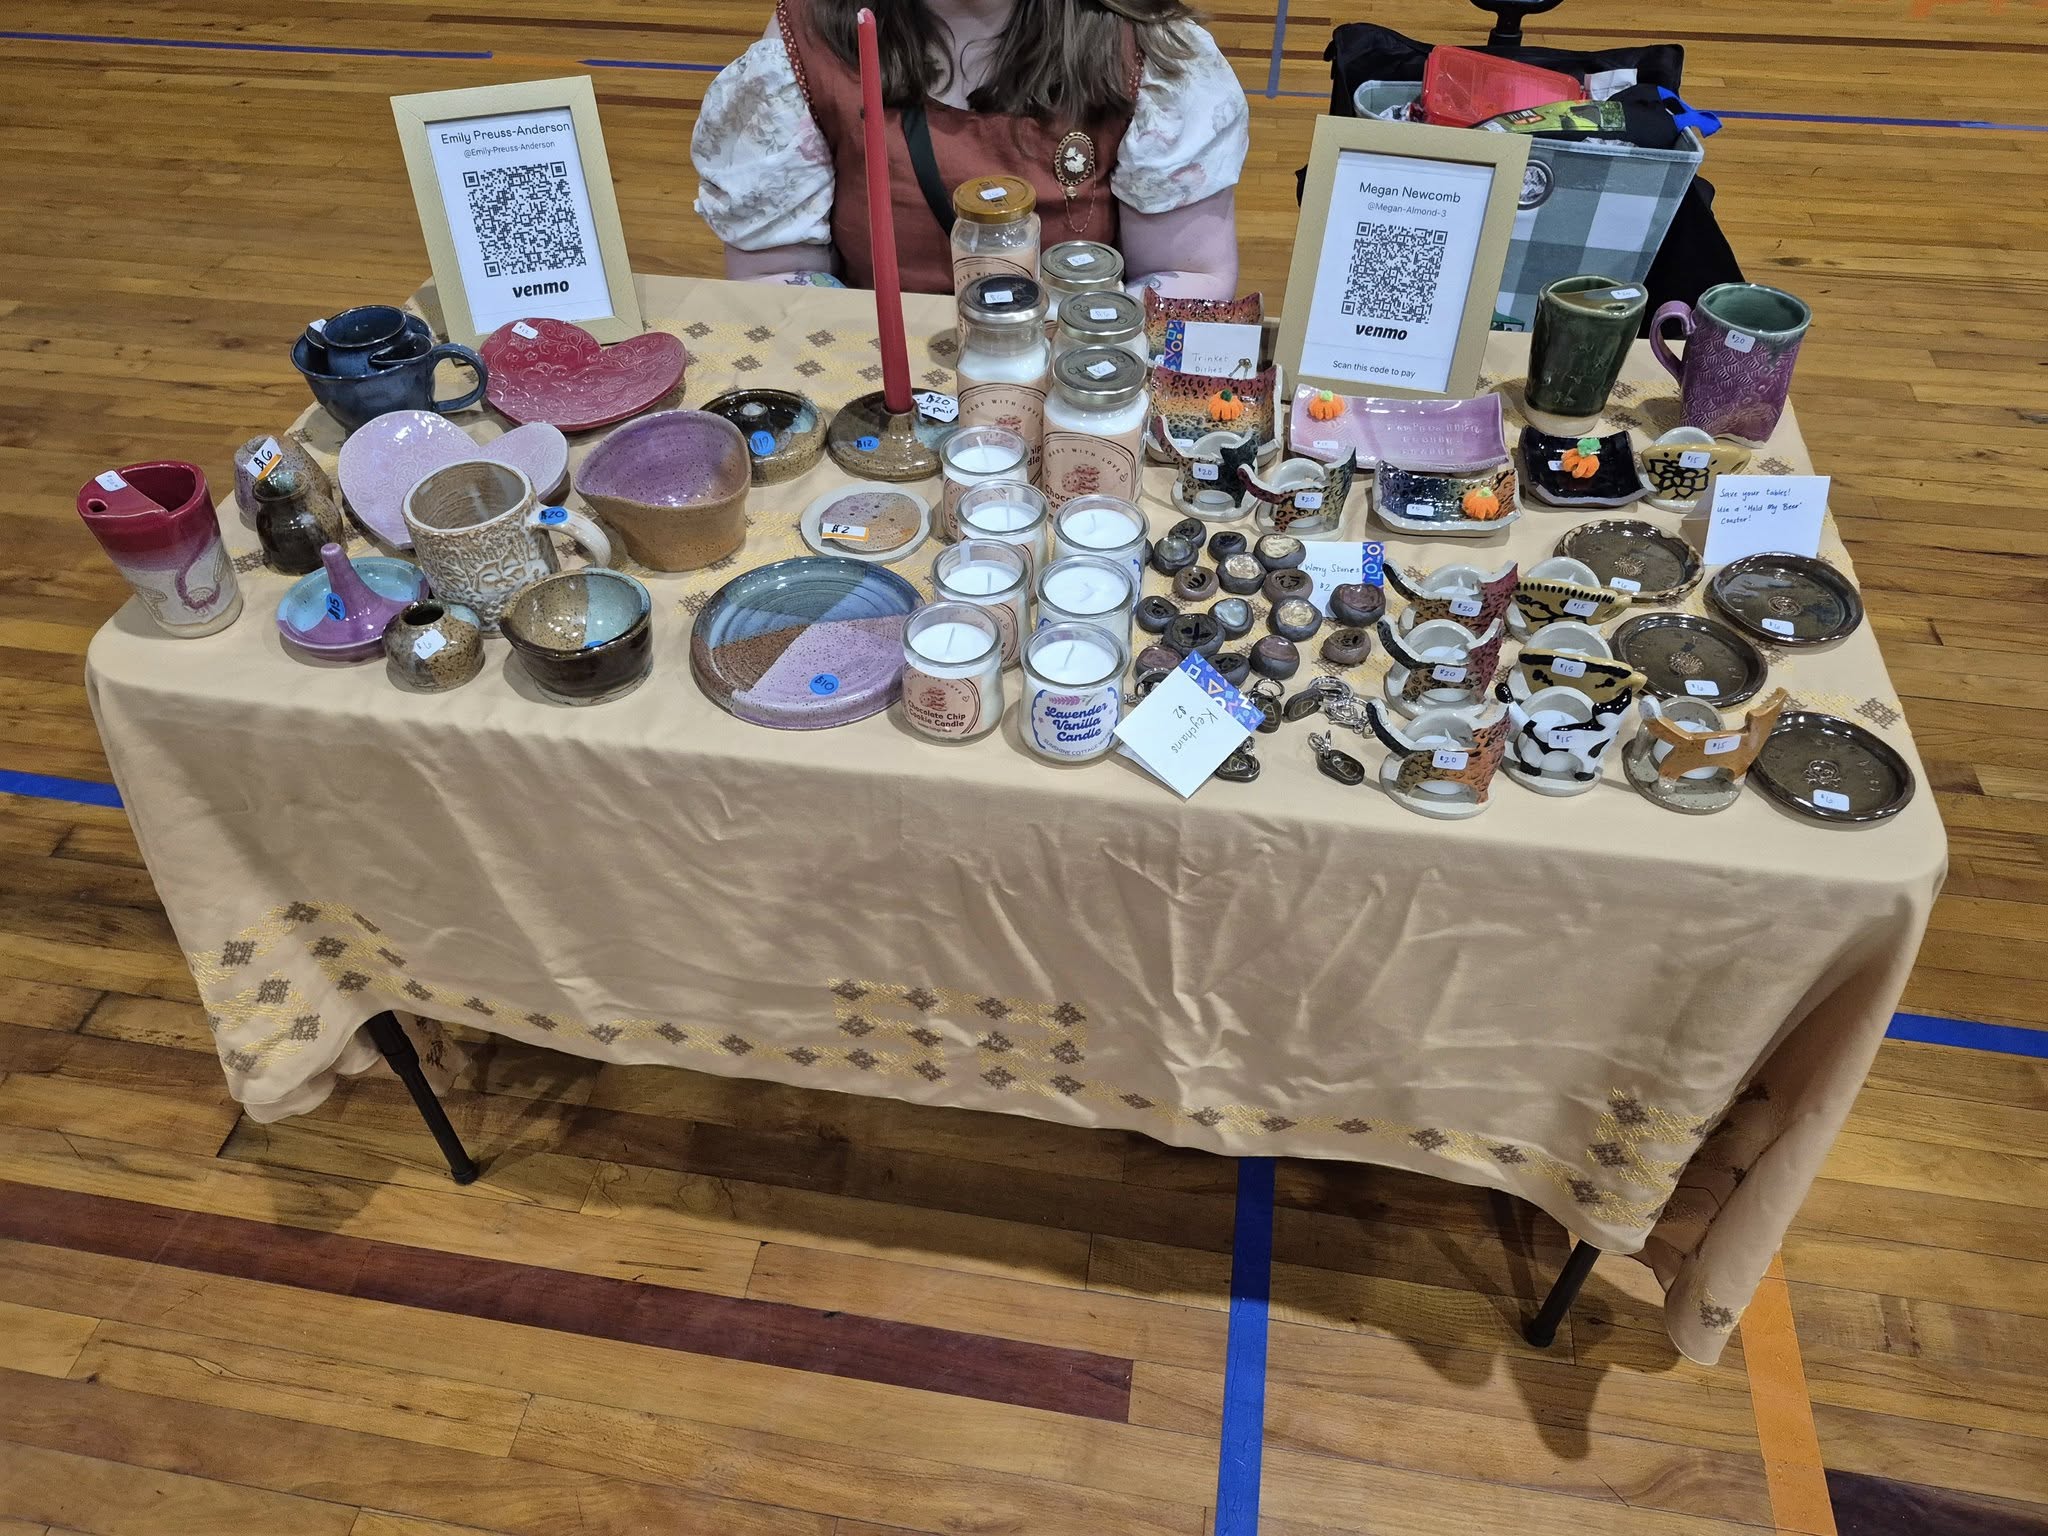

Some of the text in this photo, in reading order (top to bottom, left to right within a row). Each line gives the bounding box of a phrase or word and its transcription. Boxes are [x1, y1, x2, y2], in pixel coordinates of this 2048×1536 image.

[441, 123, 571, 144] Emily Preuss-Anderson
[464, 140, 556, 158] @Emily-Preuss-Anderson
[1359, 182, 1461, 203] Megan Newcomb
[1367, 201, 1447, 218] @Megan-Almond-3
[512, 280, 570, 298] venmo
[1355, 324, 1408, 341] venmo
[1732, 334, 1746, 344] $20
[1332, 360, 1416, 379] Scan this code to pay
[926, 394, 951, 405] $20
[932, 404, 955, 414] pair
[1719, 488, 1791, 501] Save your tables!
[1767, 503, 1778, 514] My
[1304, 563, 1360, 577] Worry Stones
[1320, 582, 1332, 592] $2
[1457, 603, 1474, 612] $20
[1573, 602, 1587, 610] $15
[1440, 669, 1456, 677] $20
[1560, 663, 1574, 673] $15
[908, 700, 966, 721] Chocolate Chip
[1044, 702, 1108, 719] Lavender
[1173, 705, 1187, 719] $2
[908, 708, 932, 725] Cookie
[934, 719, 965, 728] Candle
[1052, 716, 1101, 731] Vanilla
[1056, 728, 1102, 742] Candle
[1171, 708, 1218, 753] Keychains
[1556, 734, 1573, 744] $15
[1440, 755, 1457, 764] $20
